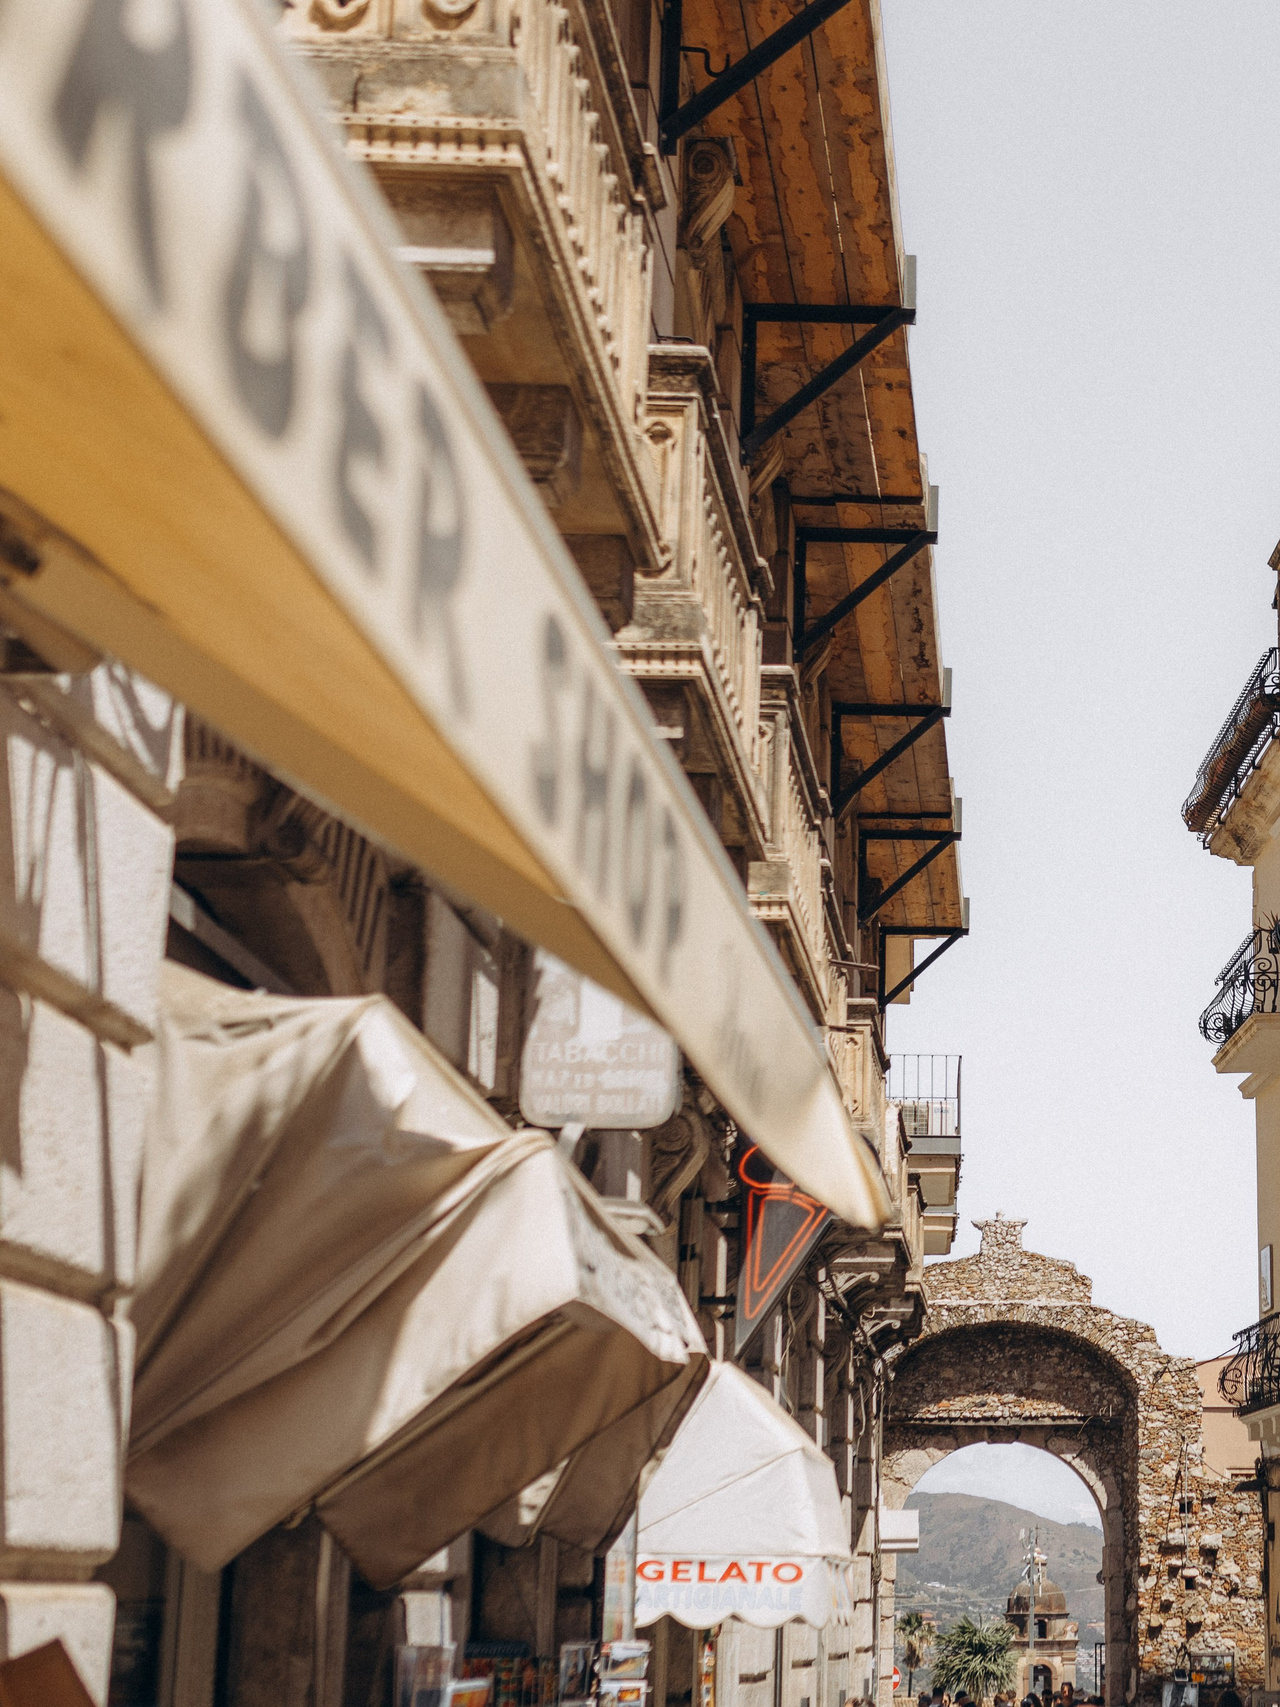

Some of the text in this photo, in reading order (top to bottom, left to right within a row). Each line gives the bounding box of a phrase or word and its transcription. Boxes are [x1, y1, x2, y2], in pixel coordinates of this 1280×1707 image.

[526, 612, 688, 990] SHOP
[532, 1042, 666, 1062] TABACCHI
[636, 1560, 803, 1583] GELATO
[638, 1585, 804, 1610] ARTIGIANALE
